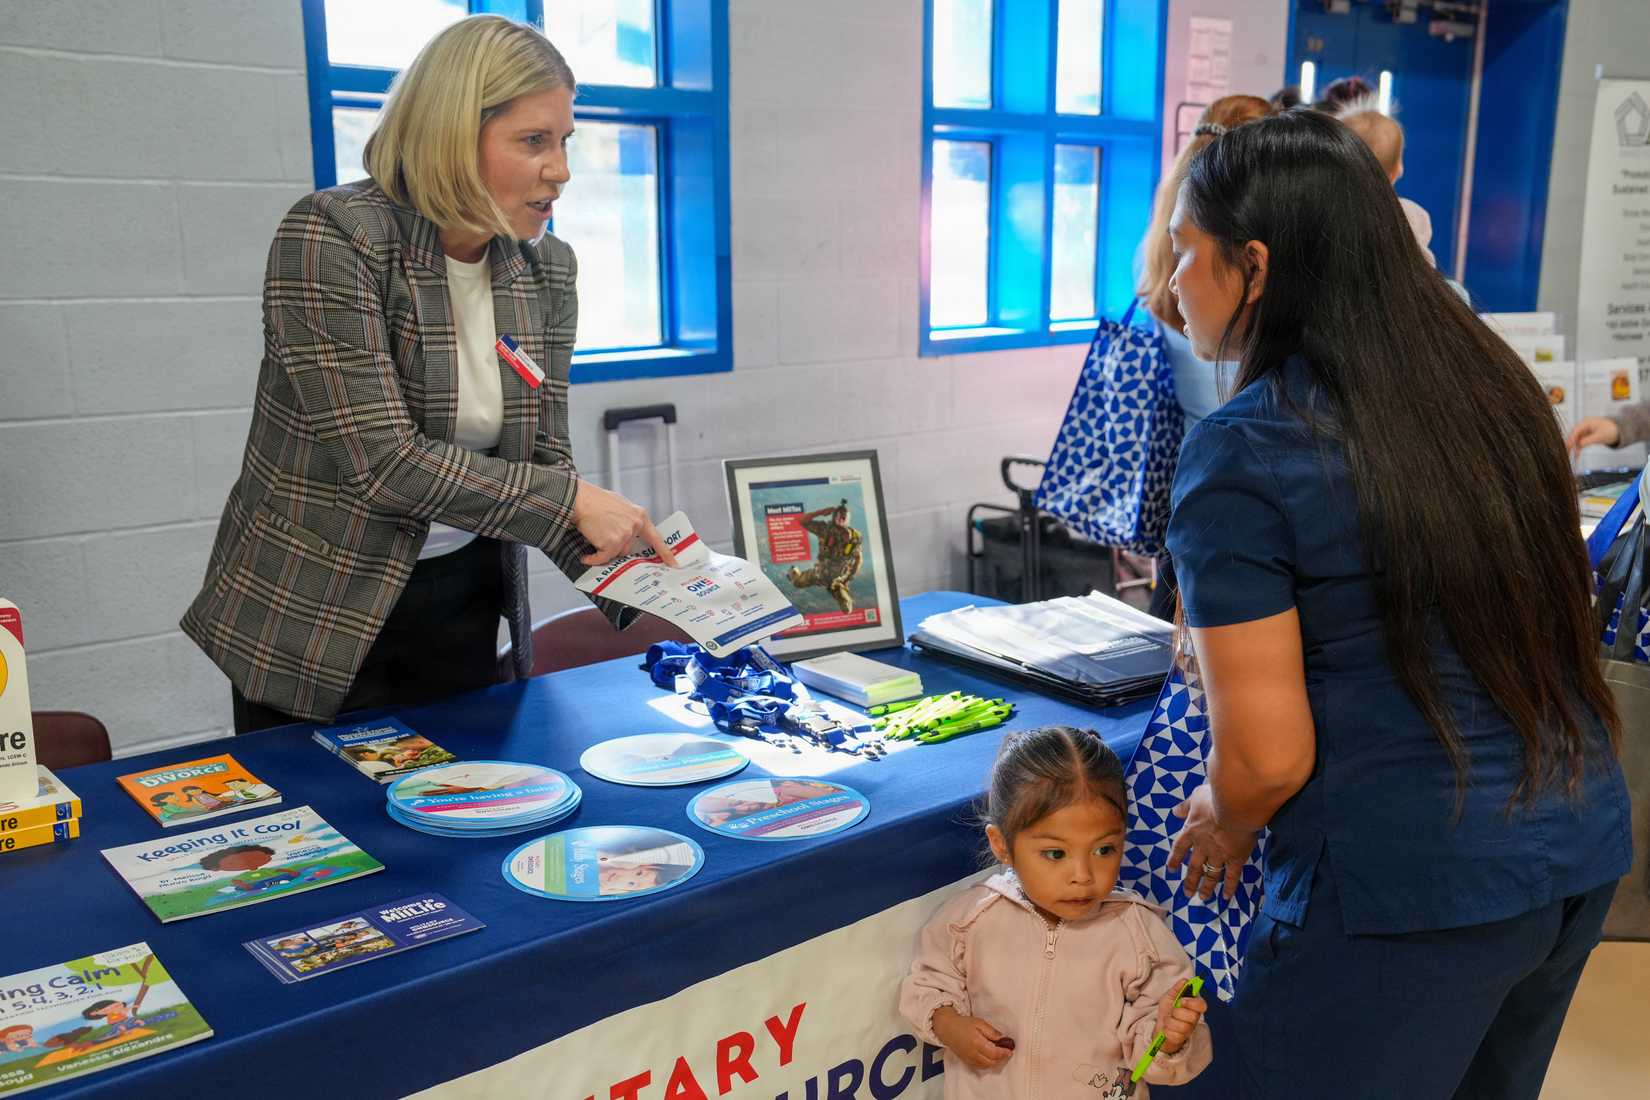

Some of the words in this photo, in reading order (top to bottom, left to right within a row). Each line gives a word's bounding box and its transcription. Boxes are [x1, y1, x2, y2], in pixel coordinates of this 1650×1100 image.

[687, 578, 713, 592] ONE
[140, 764, 226, 787] DIVORCE
[749, 803, 808, 825] Preschool
[137, 833, 228, 862] Keeping
[232, 829, 249, 839] It
[254, 820, 301, 834] Cool
[379, 901, 421, 915] Welcome
[381, 902, 447, 923] MilLife
[49, 967, 121, 989] Calm
[57, 1052, 110, 1071] Vanessa
[112, 1033, 173, 1057] Alexandre
